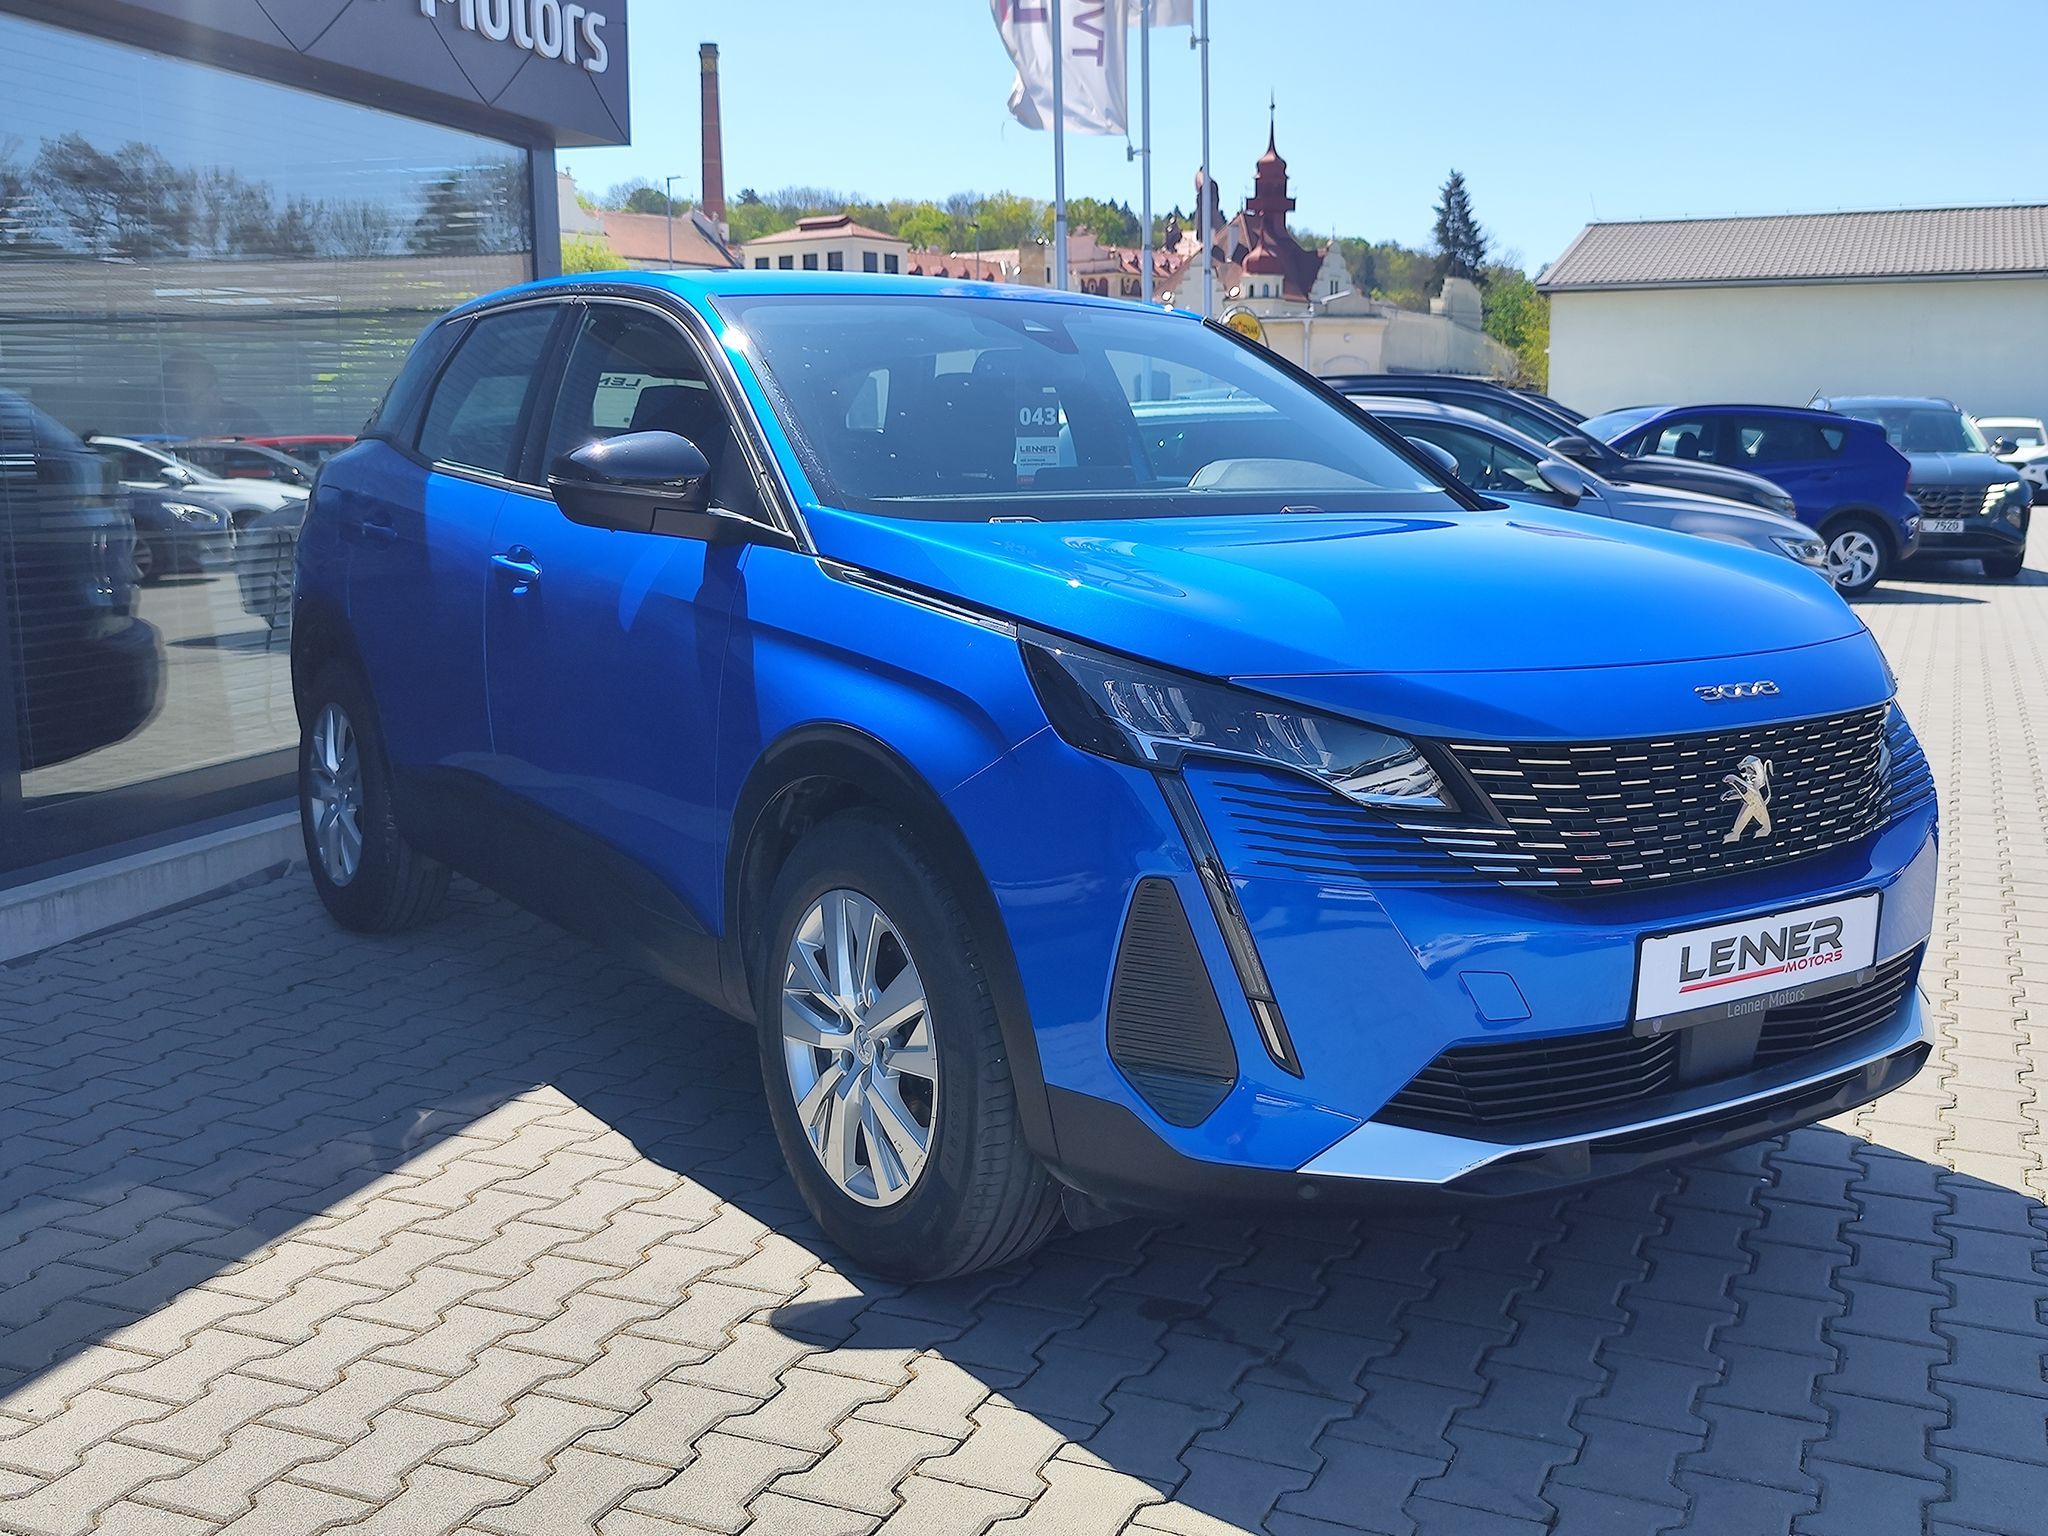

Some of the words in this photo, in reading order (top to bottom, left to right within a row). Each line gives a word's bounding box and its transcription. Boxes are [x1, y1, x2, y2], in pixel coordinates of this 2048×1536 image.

[1019, 407, 1057, 426] 043
[1019, 445, 1057, 454] LENNER
[1693, 679, 1781, 702] 3008
[1679, 916, 1843, 983] LENNER
[1784, 949, 1844, 974] MOTORS
[1727, 996, 1767, 1019] Lenner
[1768, 987, 1806, 1009] Motors
